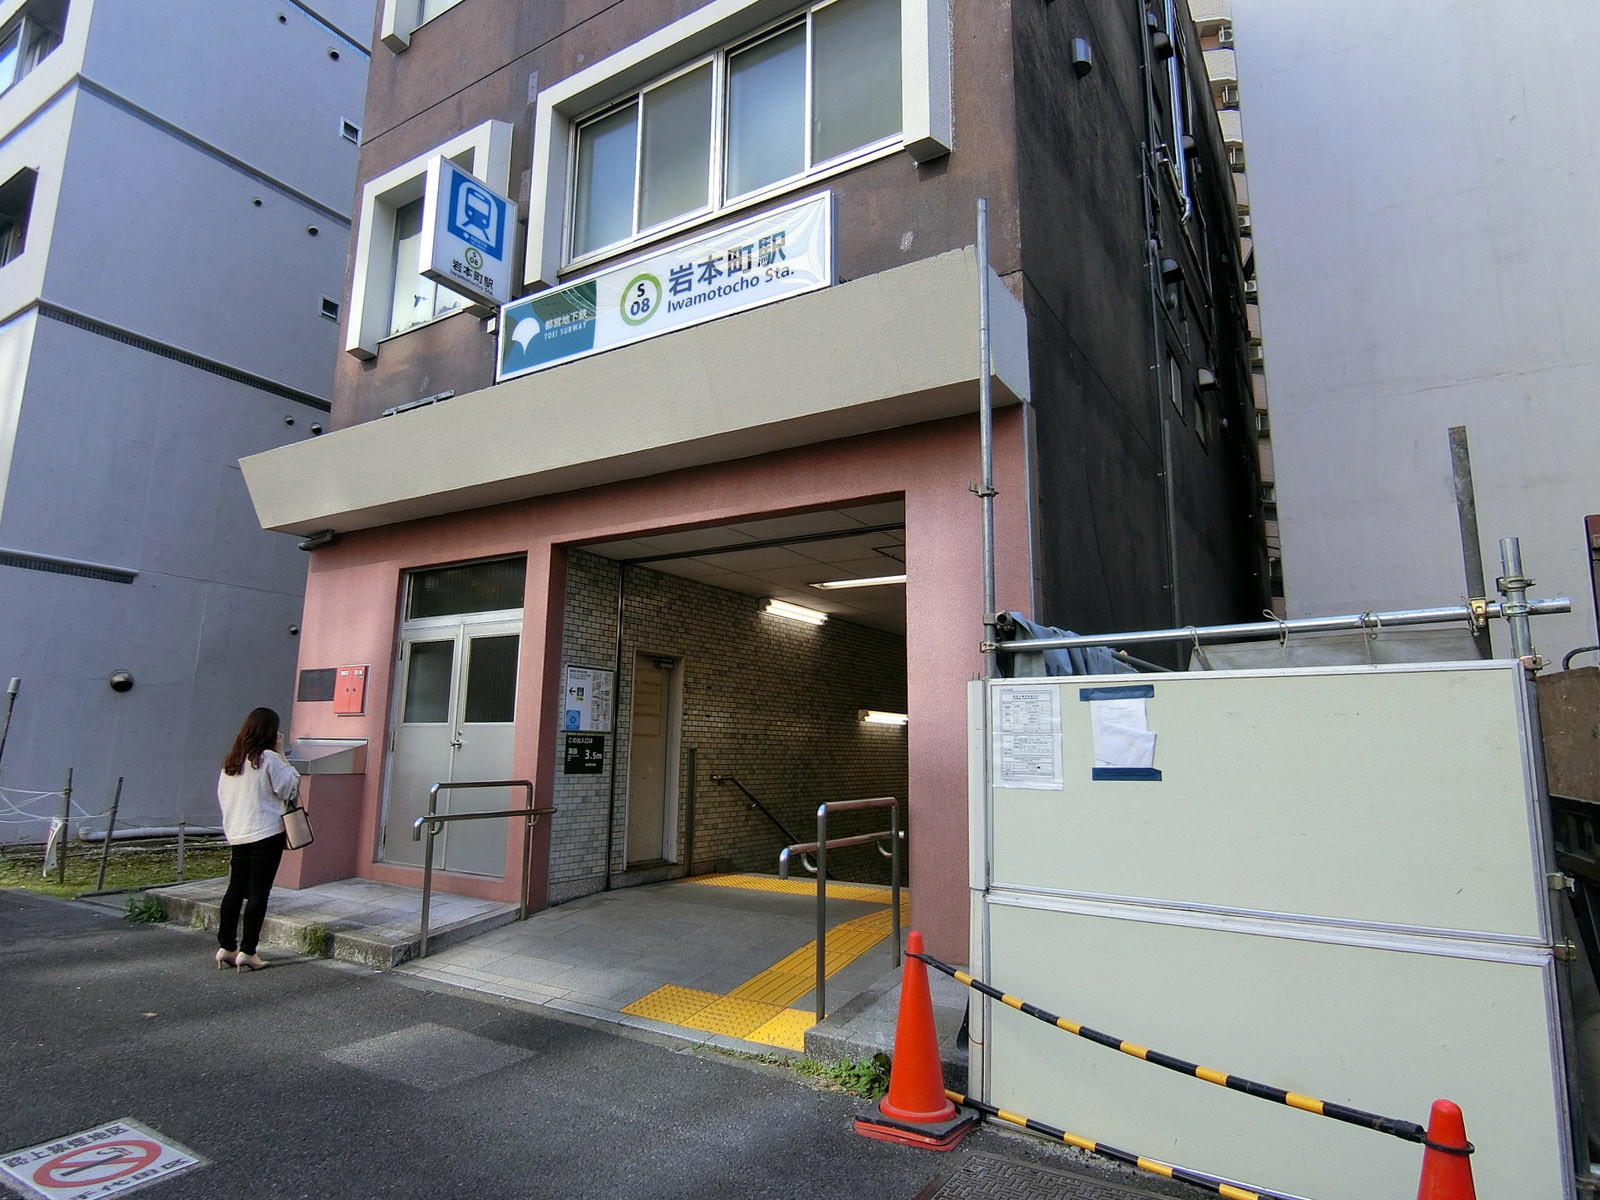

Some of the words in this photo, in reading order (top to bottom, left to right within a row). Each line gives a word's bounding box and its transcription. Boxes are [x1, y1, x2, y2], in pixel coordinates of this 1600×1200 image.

[452, 259, 494, 290] 岩本町駅
[669, 230, 786, 296] 岩本町駅
[637, 282, 646, 298] S
[667, 274, 760, 313] Iwamotocho
[765, 264, 795, 283] Sta.
[630, 297, 650, 316] 08
[544, 330, 558, 340] TOEI
[560, 321, 587, 336] SUBWAY
[584, 749, 602, 759] 3.5m
[3, 1124, 130, 1168] 路上禁煙地区
